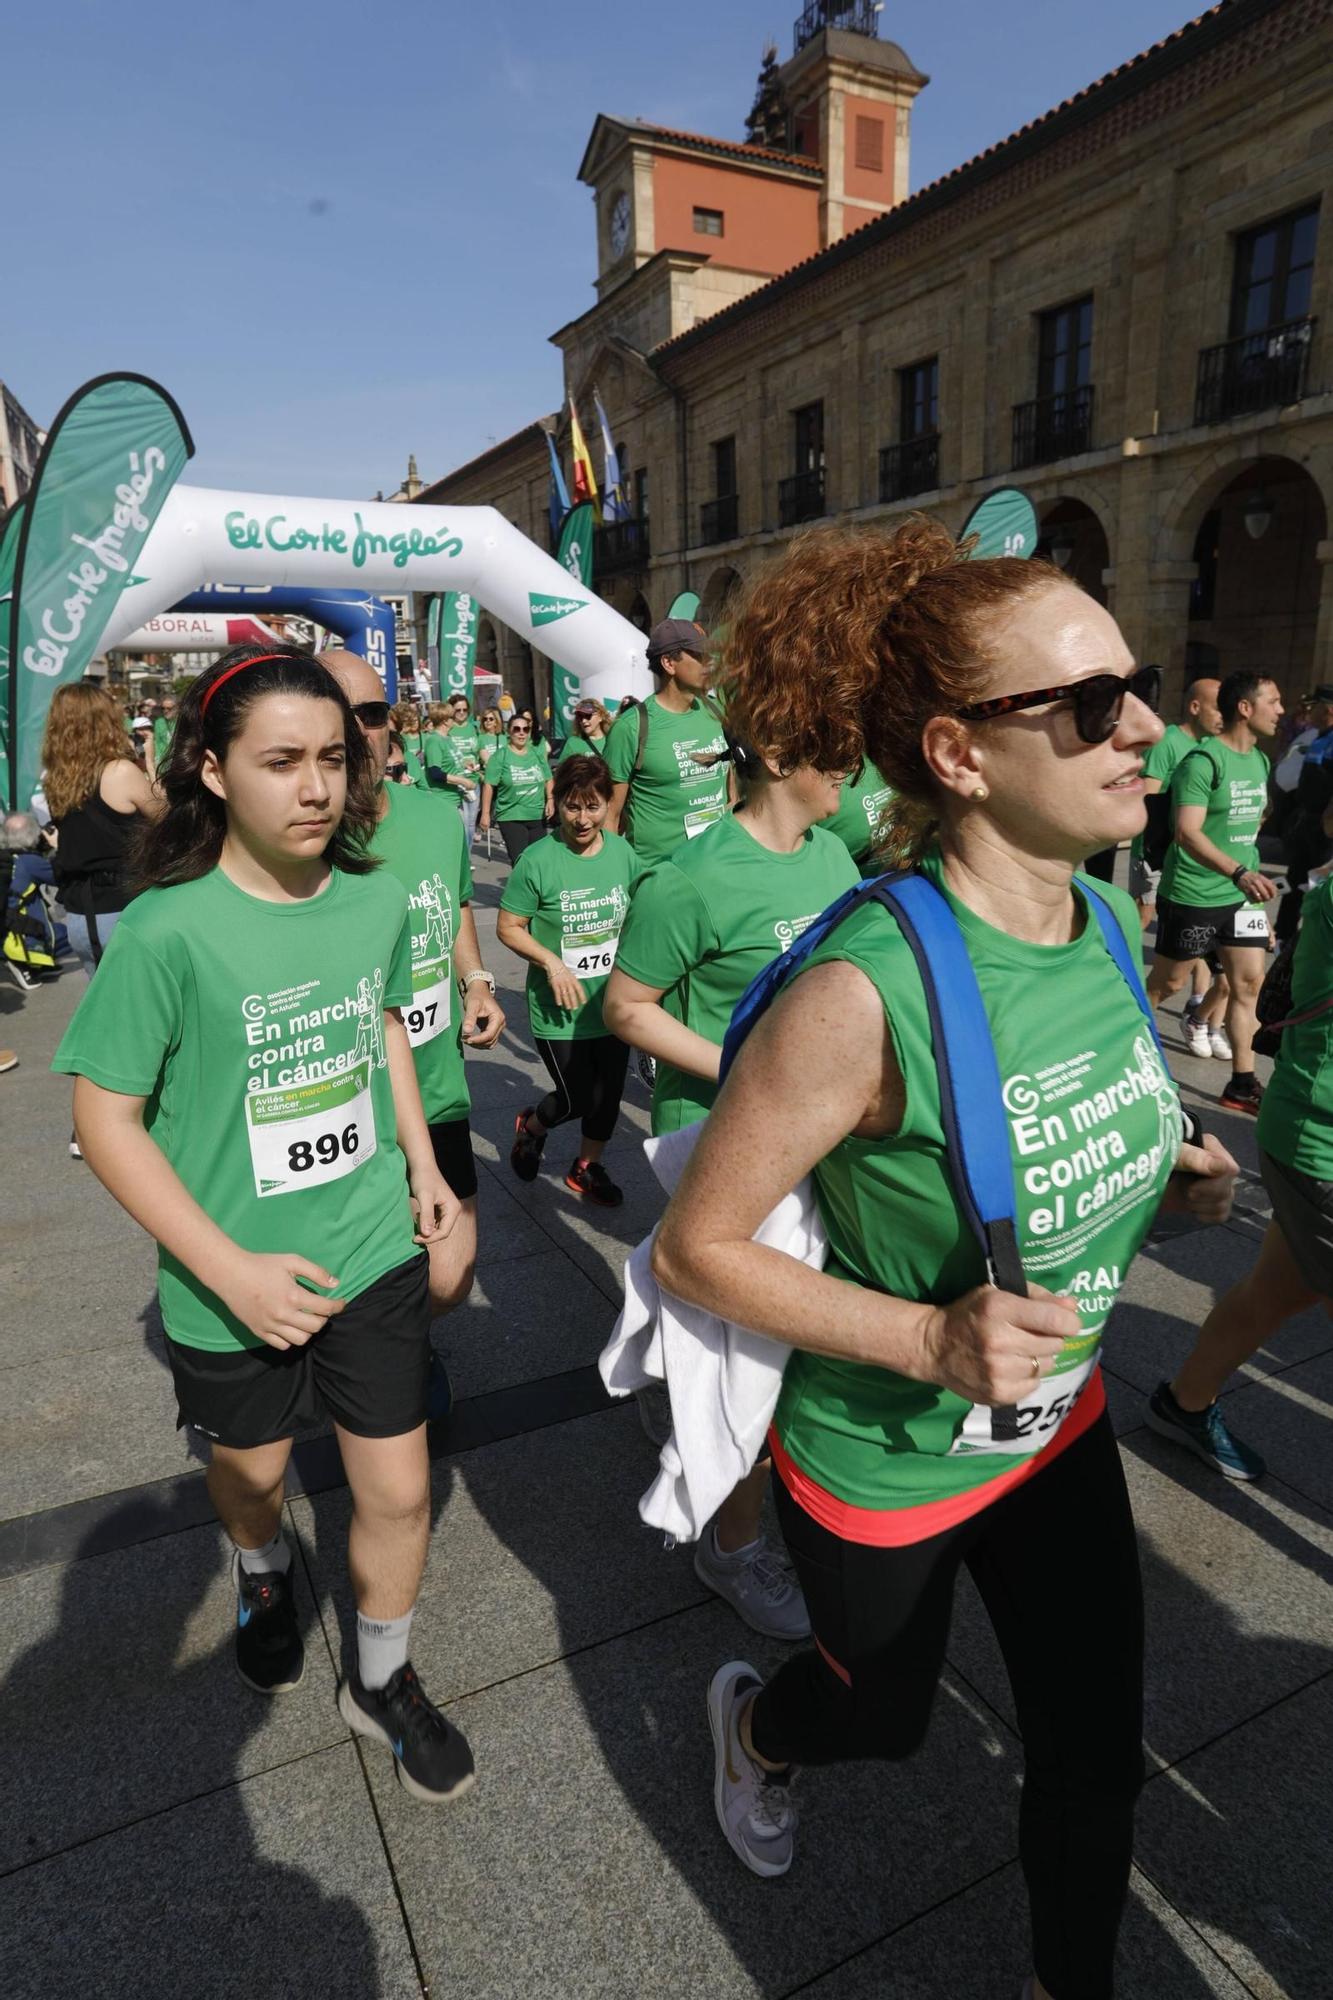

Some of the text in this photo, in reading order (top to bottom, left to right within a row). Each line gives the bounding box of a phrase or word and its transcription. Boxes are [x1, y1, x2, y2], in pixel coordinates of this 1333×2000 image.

[224, 511, 463, 568] El Corte Inglés
[23, 446, 165, 677] El Corte Inglés
[561, 901, 577, 912] En
[562, 911, 598, 922] contra
[563, 918, 614, 933] el cáncer
[577, 953, 611, 970] 476
[245, 997, 368, 1046] En marcha
[407, 1002, 438, 1034] 97
[247, 1035, 325, 1069] contra
[247, 1049, 358, 1091] el cáncer
[255, 1094, 285, 1107] Avilés
[299, 1082, 331, 1099] marcha
[332, 1074, 354, 1088] contra
[256, 1100, 300, 1114] el cáncer
[1011, 1067, 1161, 1155] En marcha
[288, 1123, 359, 1172] 896
[1024, 1130, 1127, 1195] contra
[1028, 1195, 1065, 1235] el
[1075, 1145, 1163, 1218] cáncer
